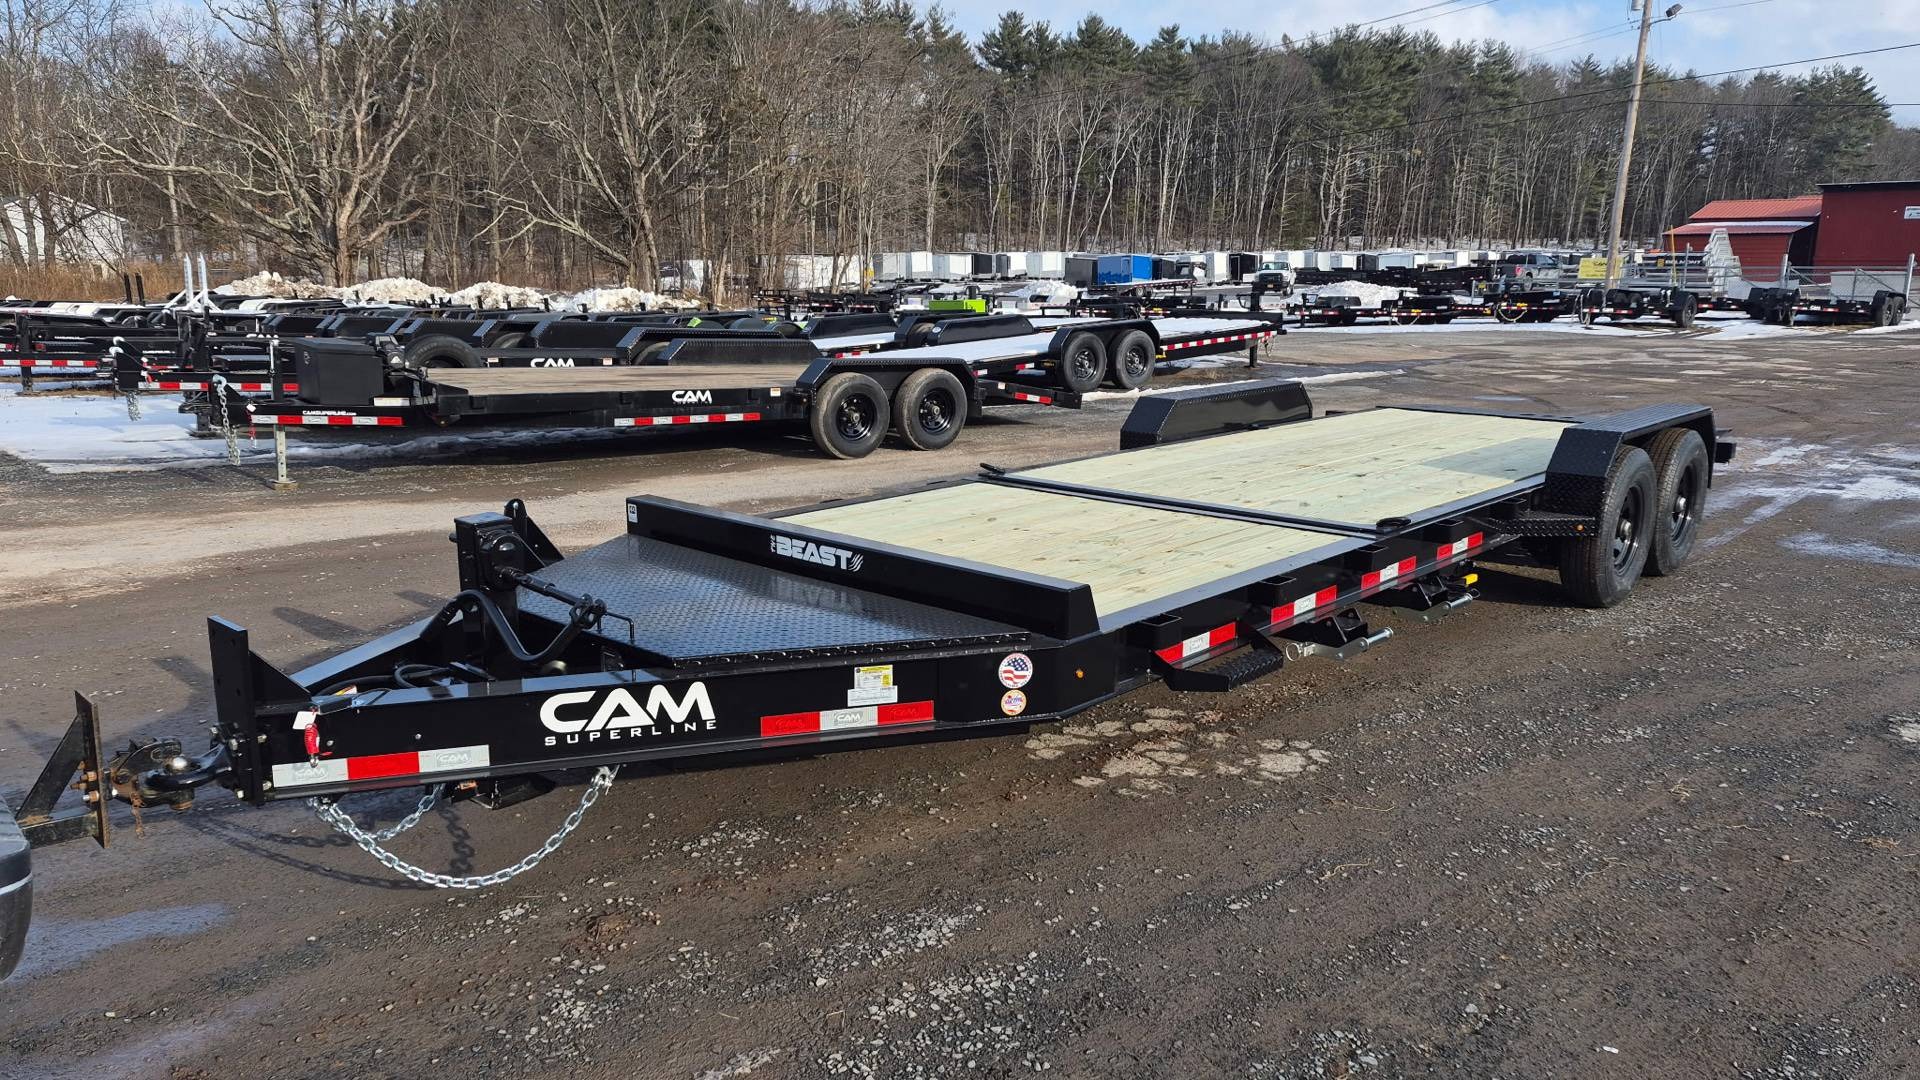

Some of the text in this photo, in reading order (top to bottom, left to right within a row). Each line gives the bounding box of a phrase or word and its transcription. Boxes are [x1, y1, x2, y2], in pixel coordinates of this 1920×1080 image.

[671, 389, 713, 404] CAM
[775, 534, 853, 570] BEAST
[538, 681, 716, 733] CAM
[835, 712, 862, 724] CAM
[544, 719, 717, 746] SUPERLINE
[437, 751, 468, 764] CAM
